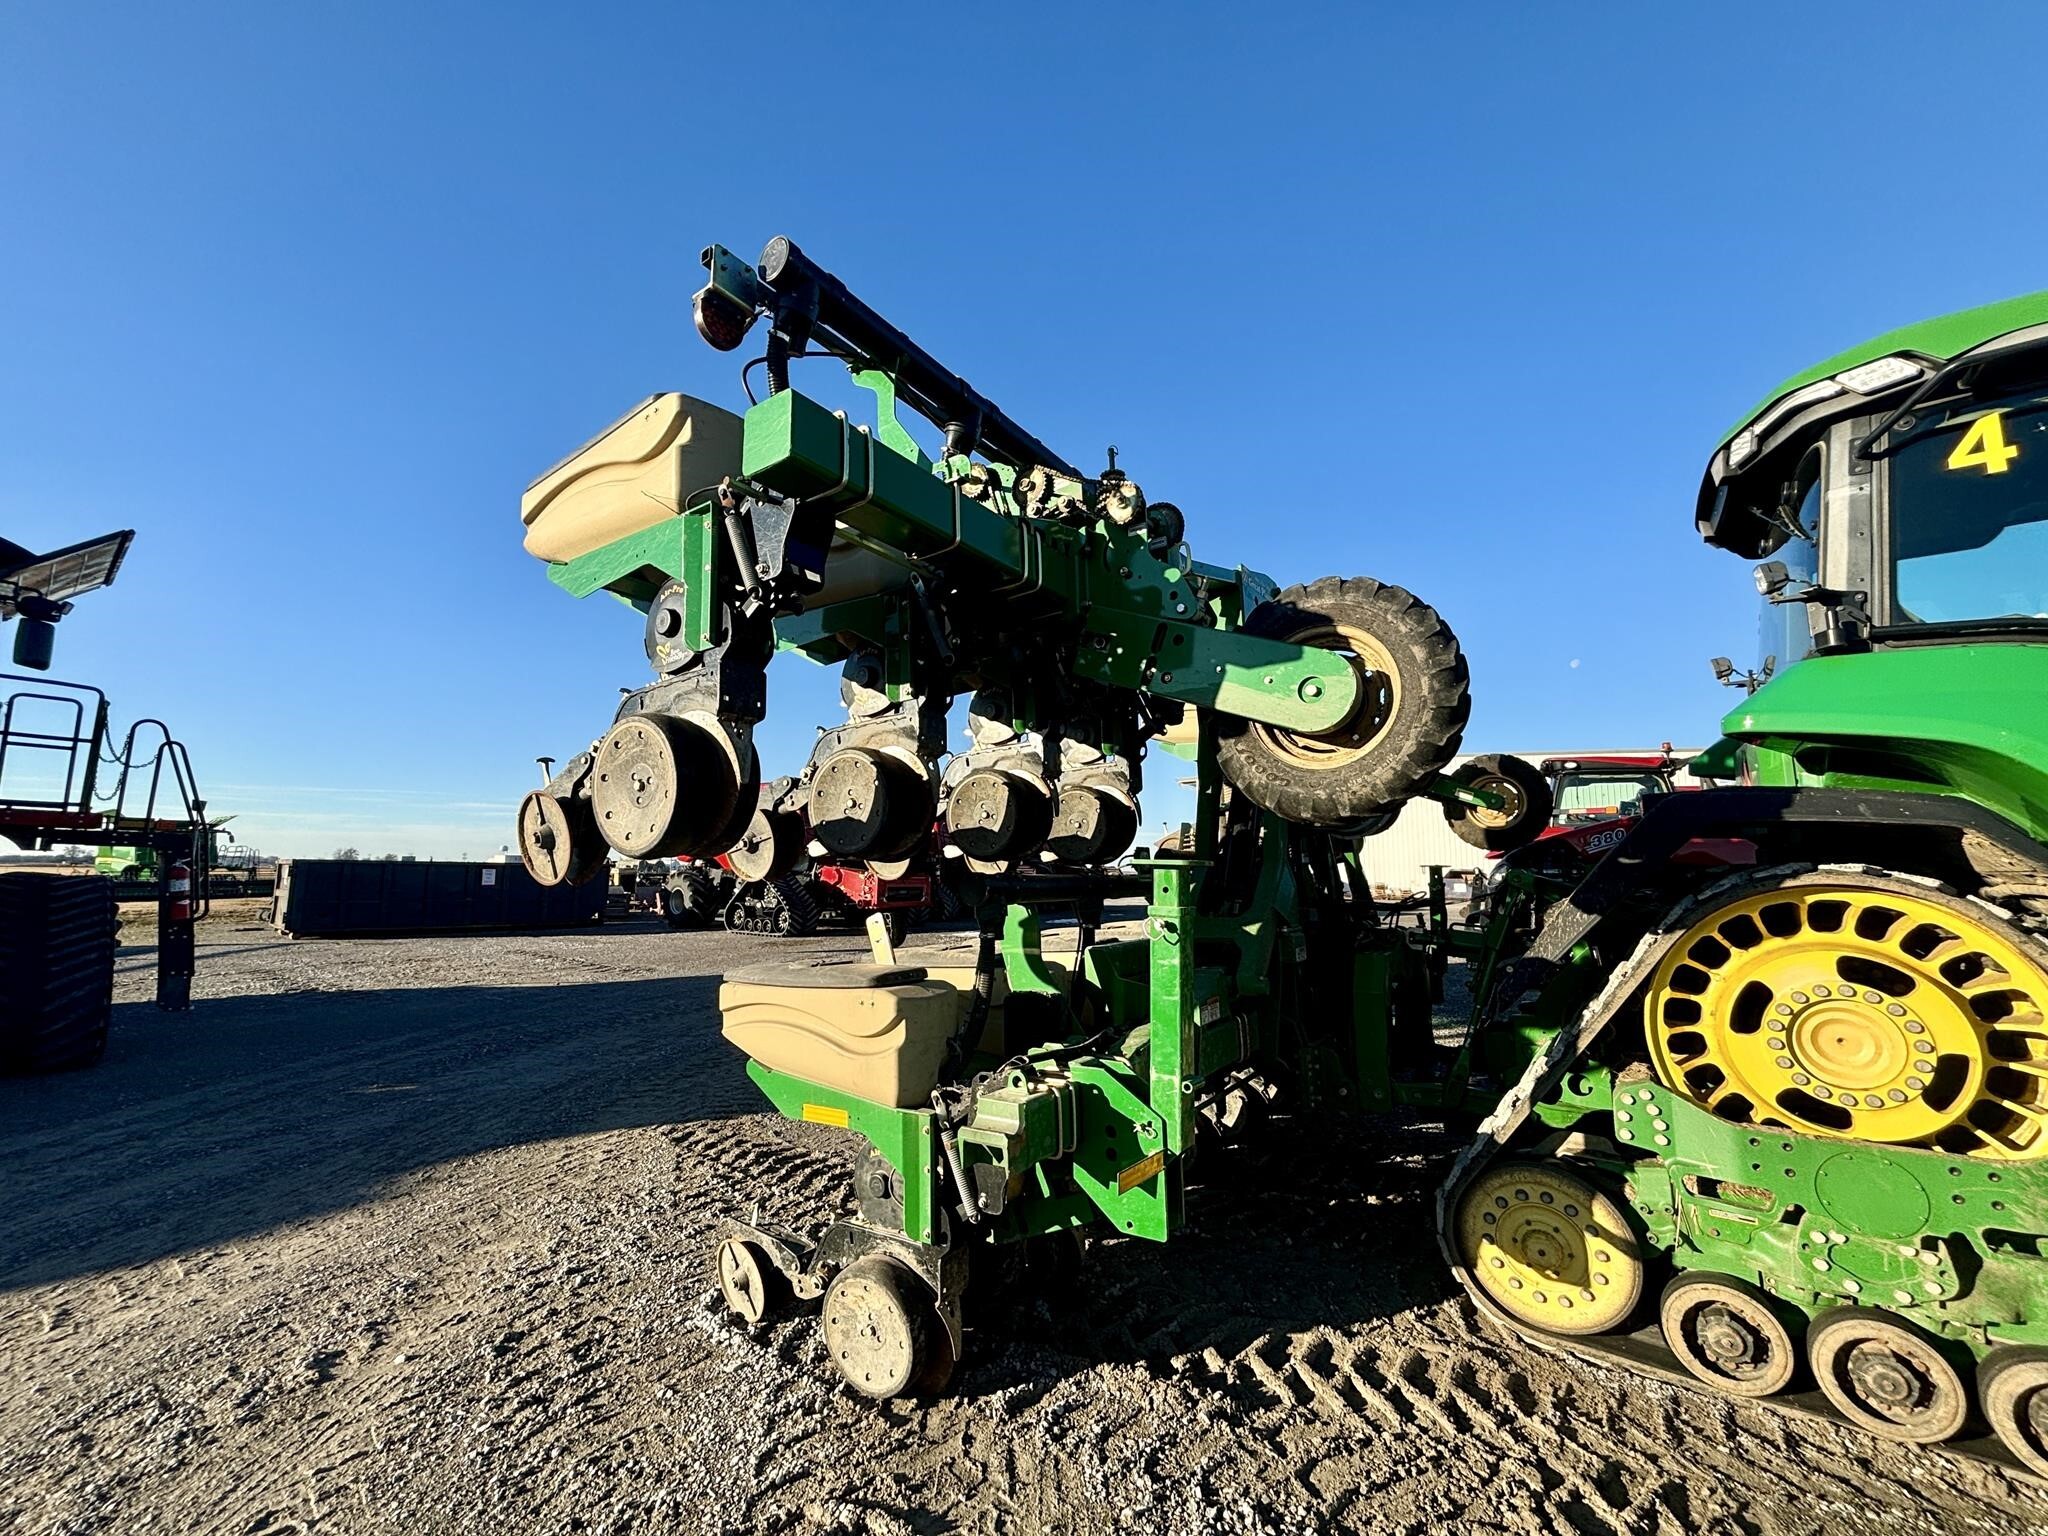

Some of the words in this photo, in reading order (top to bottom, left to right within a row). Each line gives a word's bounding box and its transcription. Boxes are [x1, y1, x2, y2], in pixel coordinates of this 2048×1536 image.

[1947, 411, 2018, 474] 4
[660, 585, 684, 602] Air-Pro
[1590, 827, 1626, 849] 380
